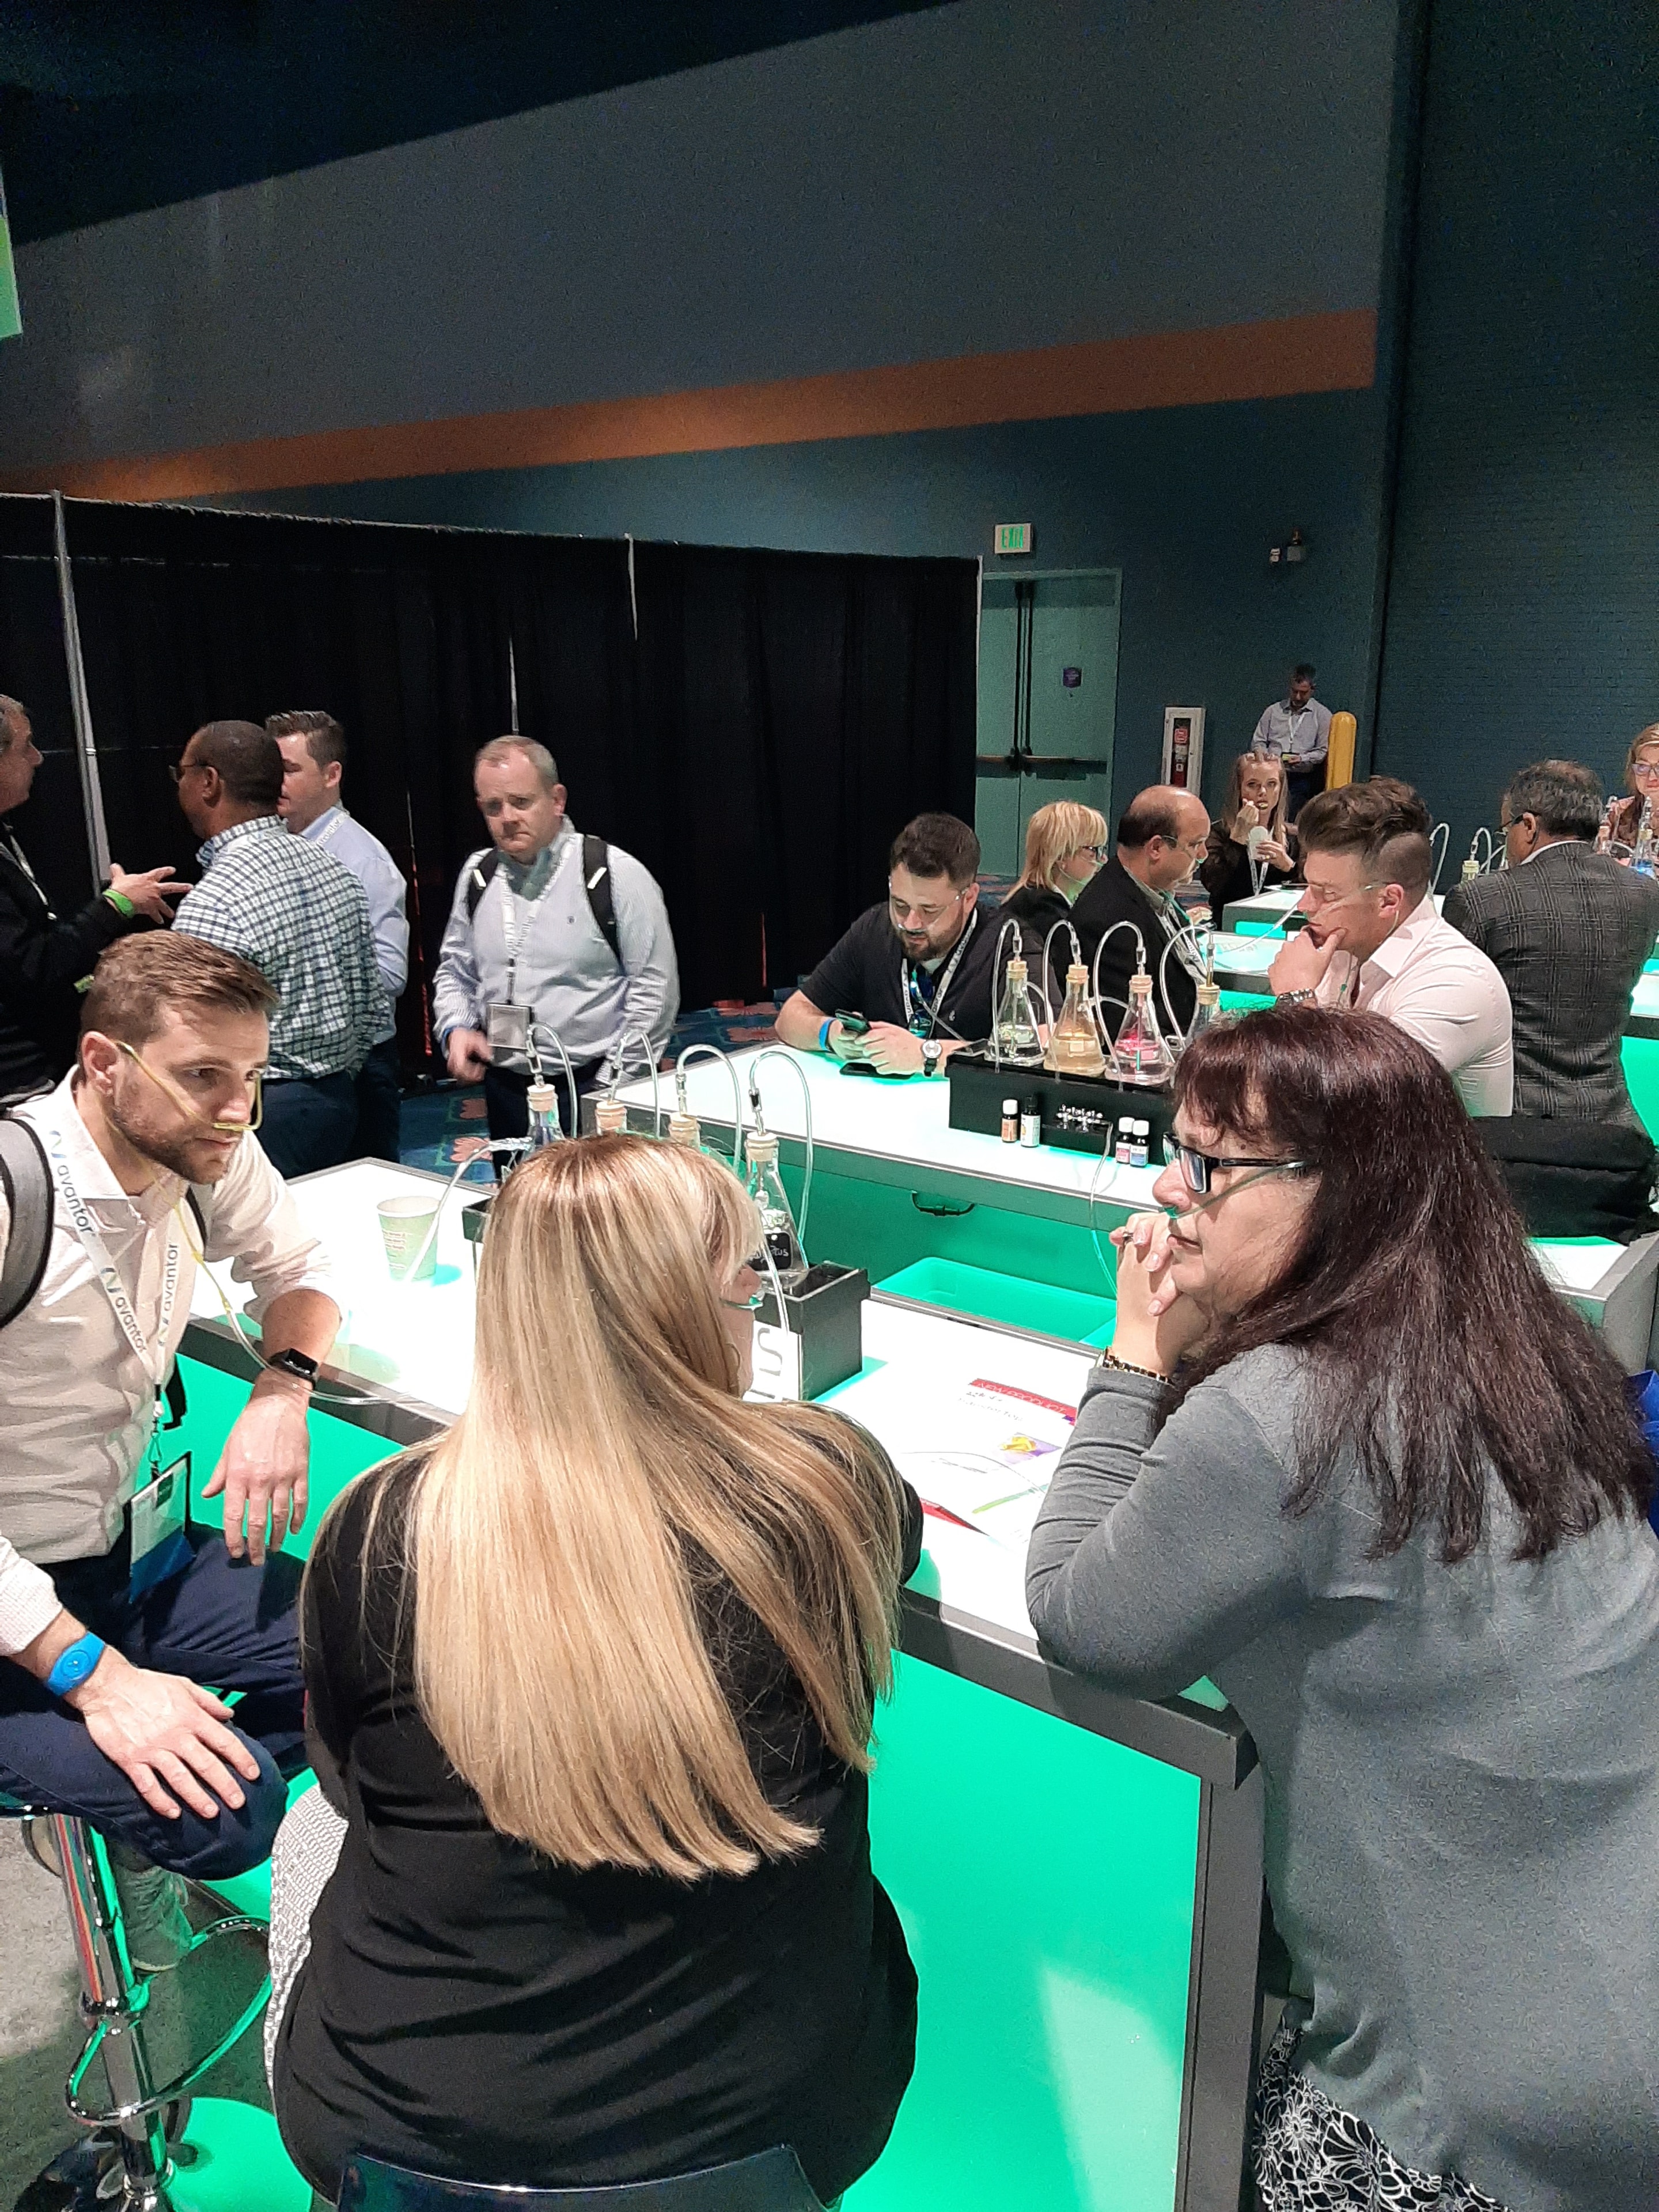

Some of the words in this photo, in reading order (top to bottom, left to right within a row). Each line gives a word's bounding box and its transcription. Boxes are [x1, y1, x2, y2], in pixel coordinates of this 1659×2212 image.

[1001, 527, 1023, 549] EXIT
[57, 1165, 94, 1232] avantor
[164, 1244, 179, 1312] avantor
